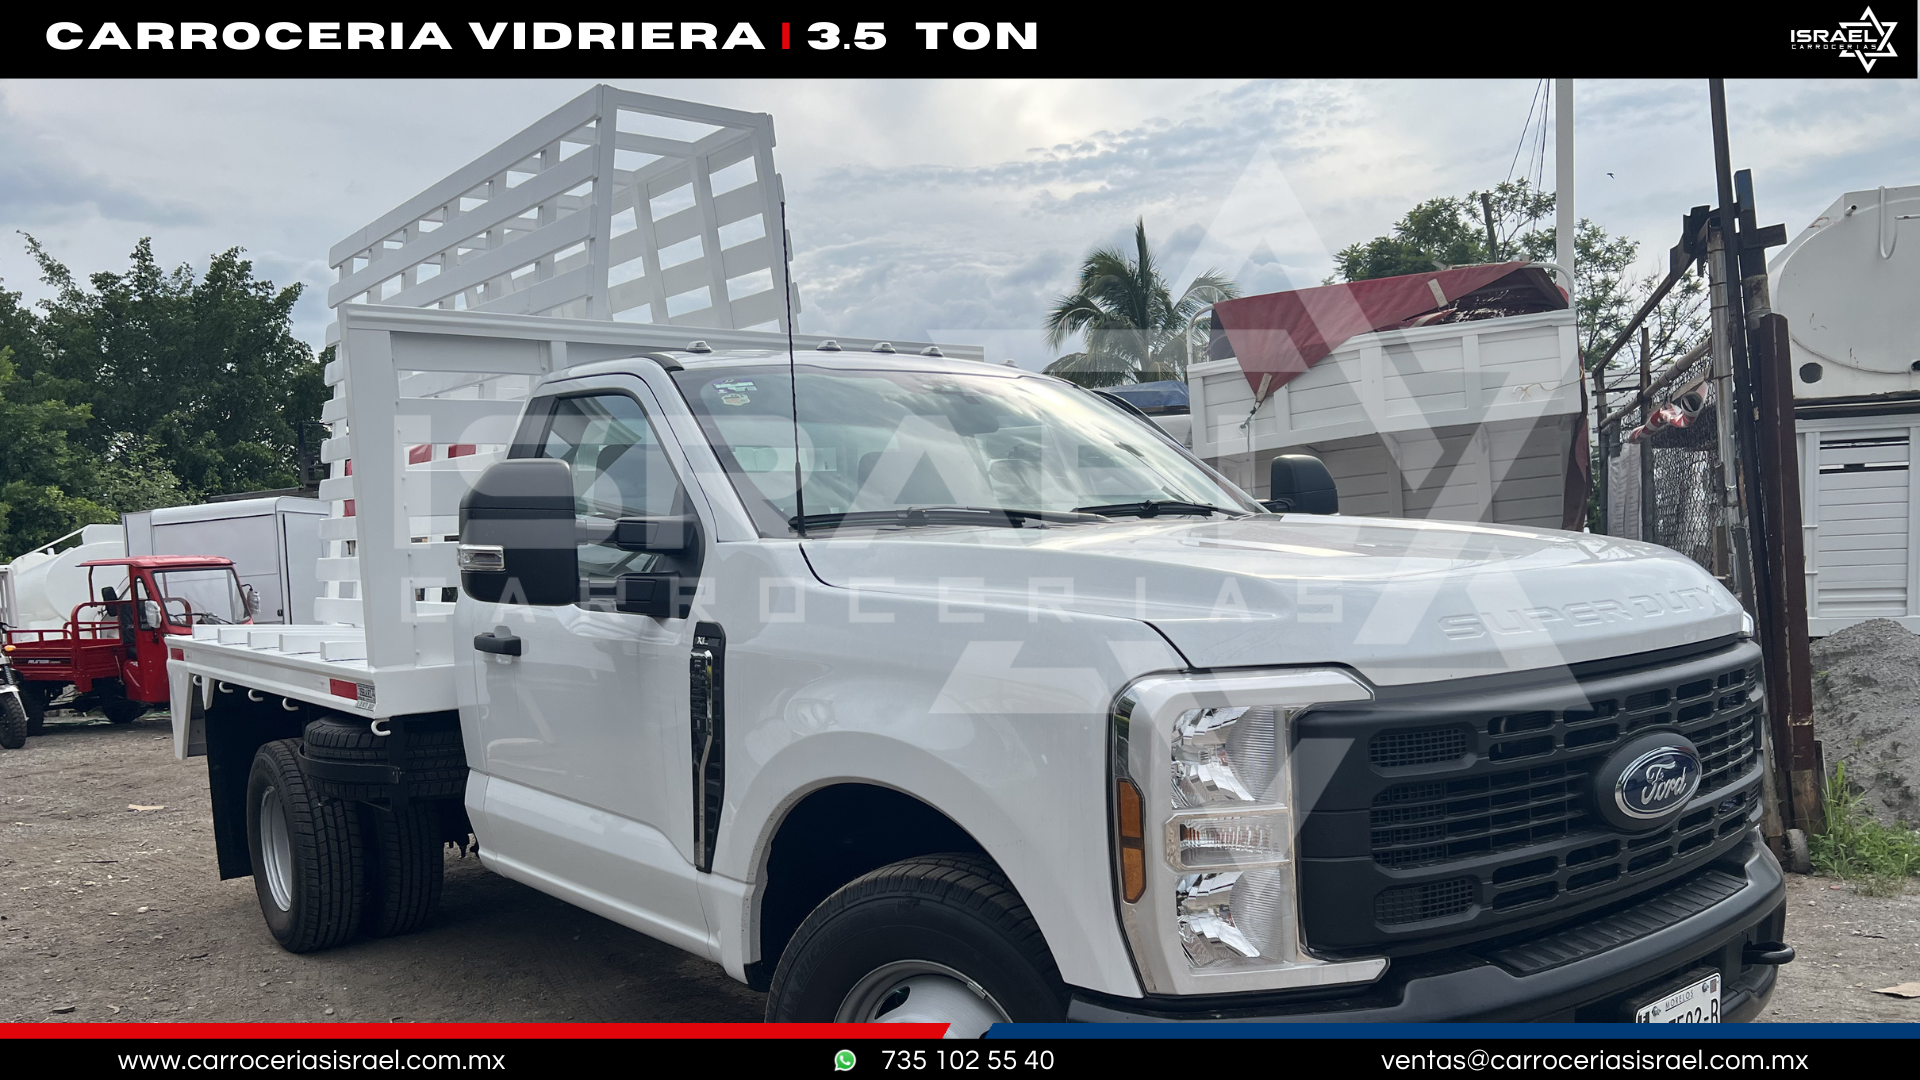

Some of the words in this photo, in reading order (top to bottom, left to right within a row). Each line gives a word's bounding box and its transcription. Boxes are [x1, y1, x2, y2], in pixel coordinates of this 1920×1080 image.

[696, 636, 709, 646] XL
[1641, 760, 1687, 805] Ford
[1664, 988, 1695, 1009] MORELOS
